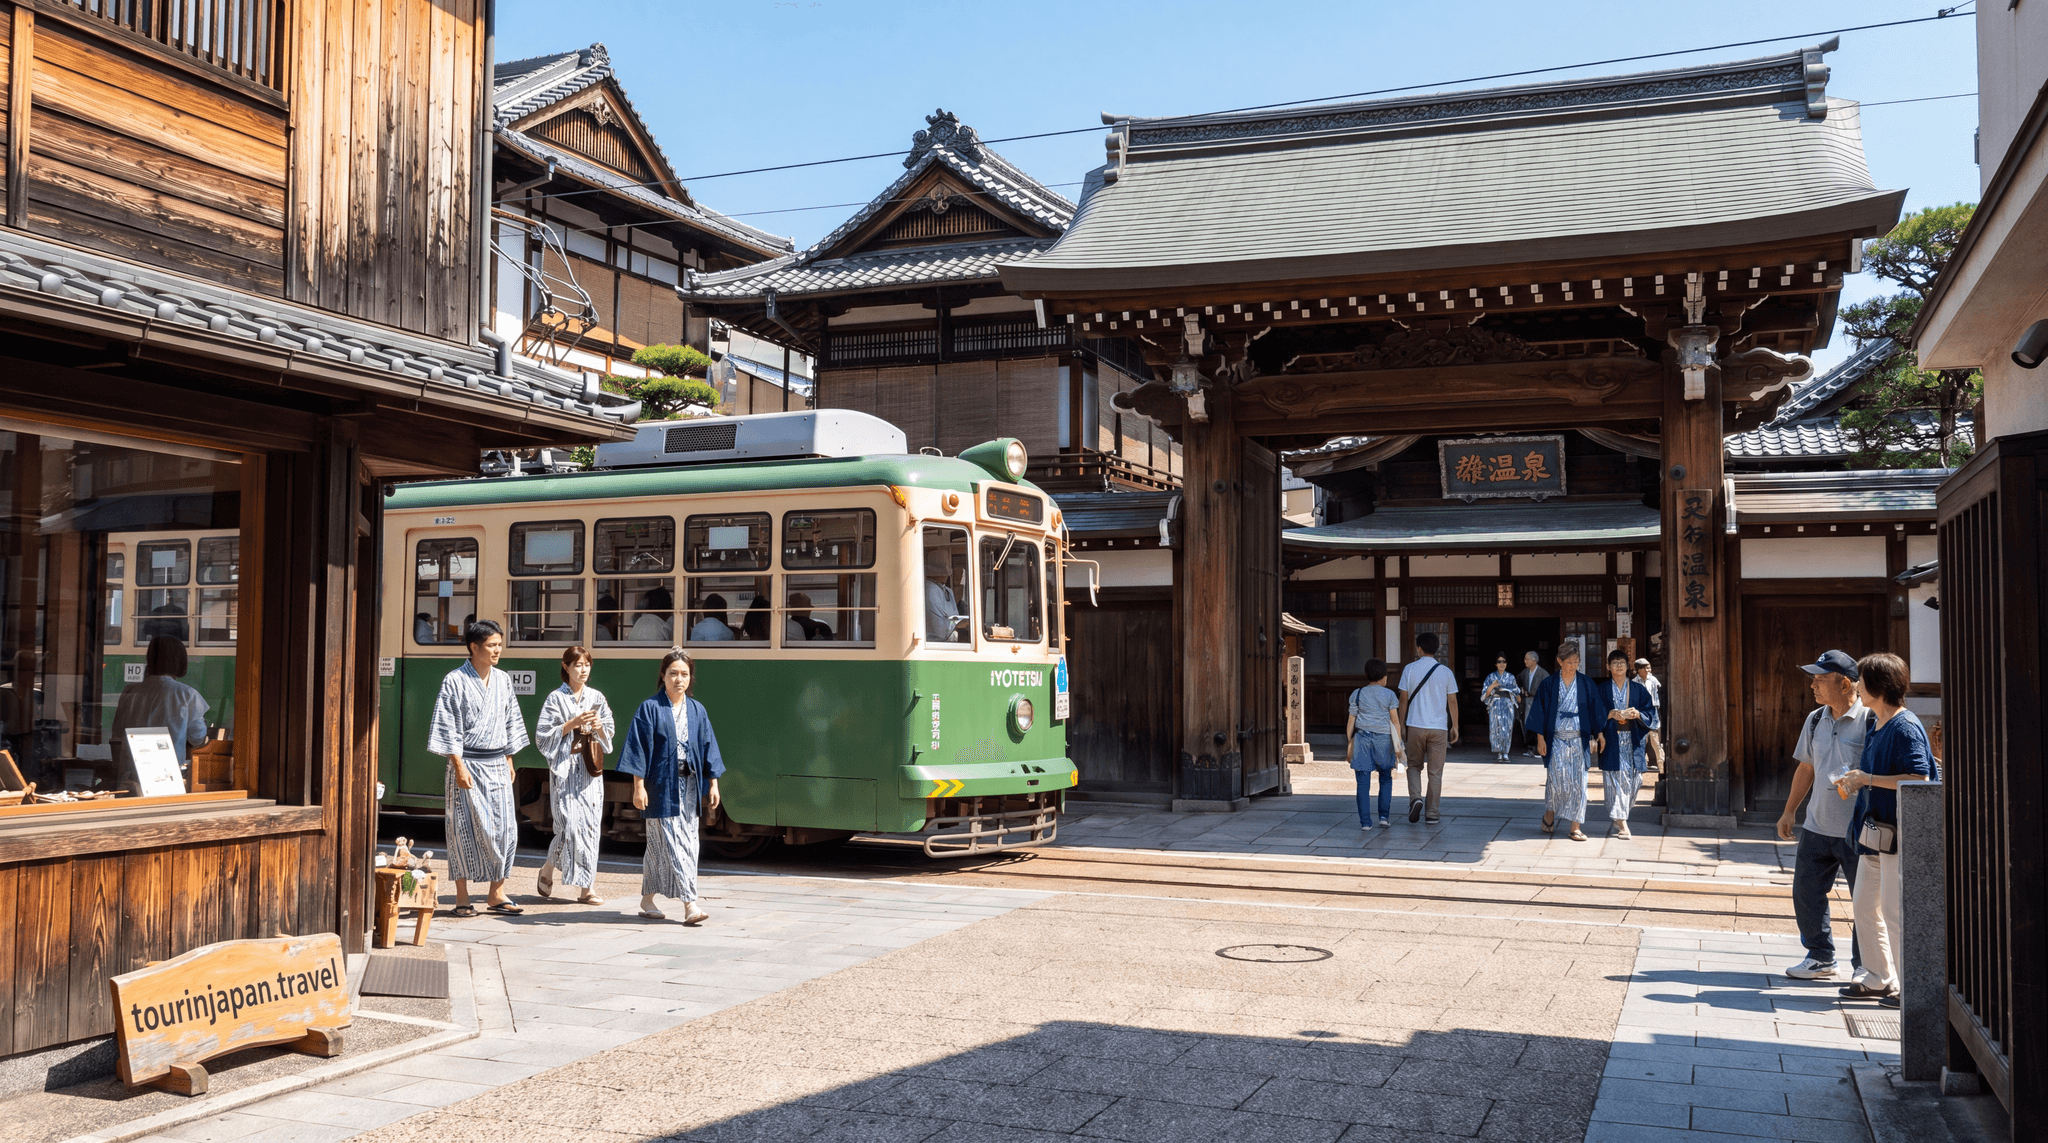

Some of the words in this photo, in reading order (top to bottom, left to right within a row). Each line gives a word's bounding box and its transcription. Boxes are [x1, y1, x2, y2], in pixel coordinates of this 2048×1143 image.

[127, 665, 142, 675] HD
[512, 674, 532, 685] HD
[990, 669, 1043, 688] IYOTETSU
[131, 957, 339, 1033] tourinjapan.travel
